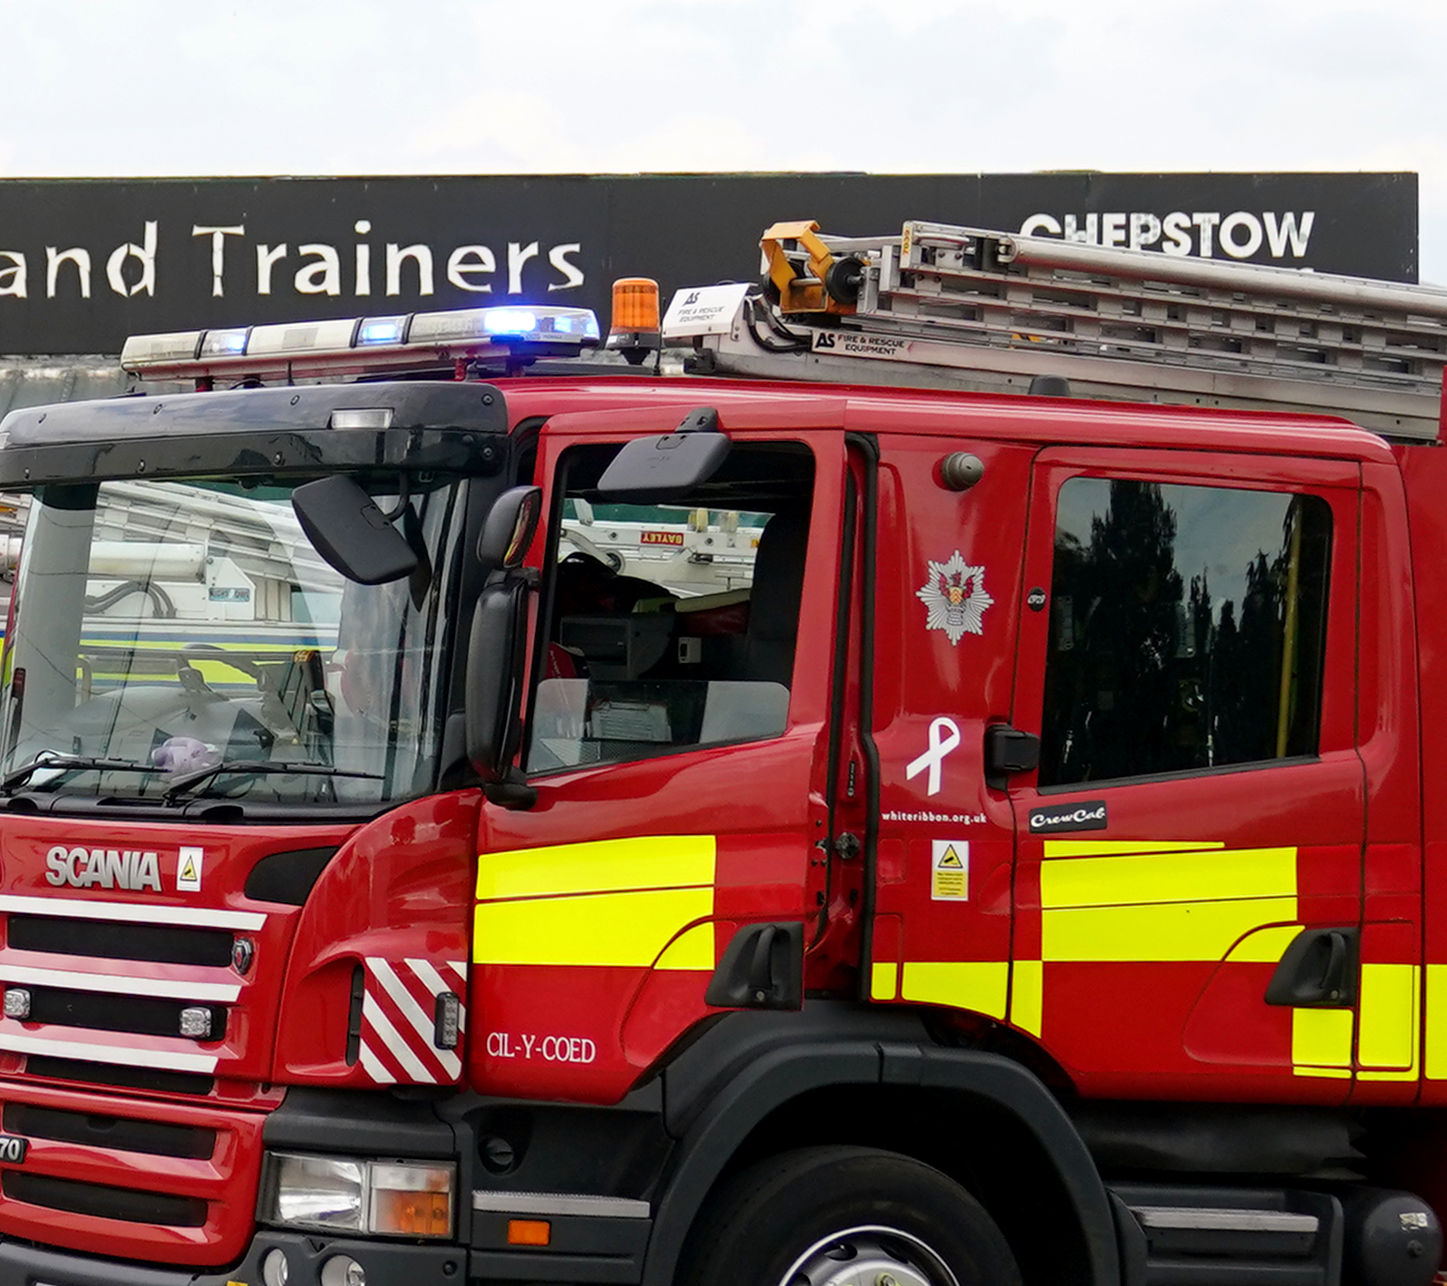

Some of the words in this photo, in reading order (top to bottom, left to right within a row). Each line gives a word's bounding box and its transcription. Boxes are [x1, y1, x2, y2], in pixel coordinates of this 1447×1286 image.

[192, 219, 585, 297] Trainers
[682, 292, 702, 307] AS
[815, 332, 836, 349] AS
[837, 335, 859, 344] FIRE
[860, 336, 867, 344] &
[868, 337, 906, 349] RESCUE
[844, 343, 897, 356] EQUIPMENT
[642, 533, 682, 544] BAYLEY
[882, 810, 987, 825] whiteribbon.org.uk
[1029, 806, 1106, 828] CrewCab
[45, 845, 162, 892] SCANIA
[486, 1032, 596, 1064] CIL-Y-COED
